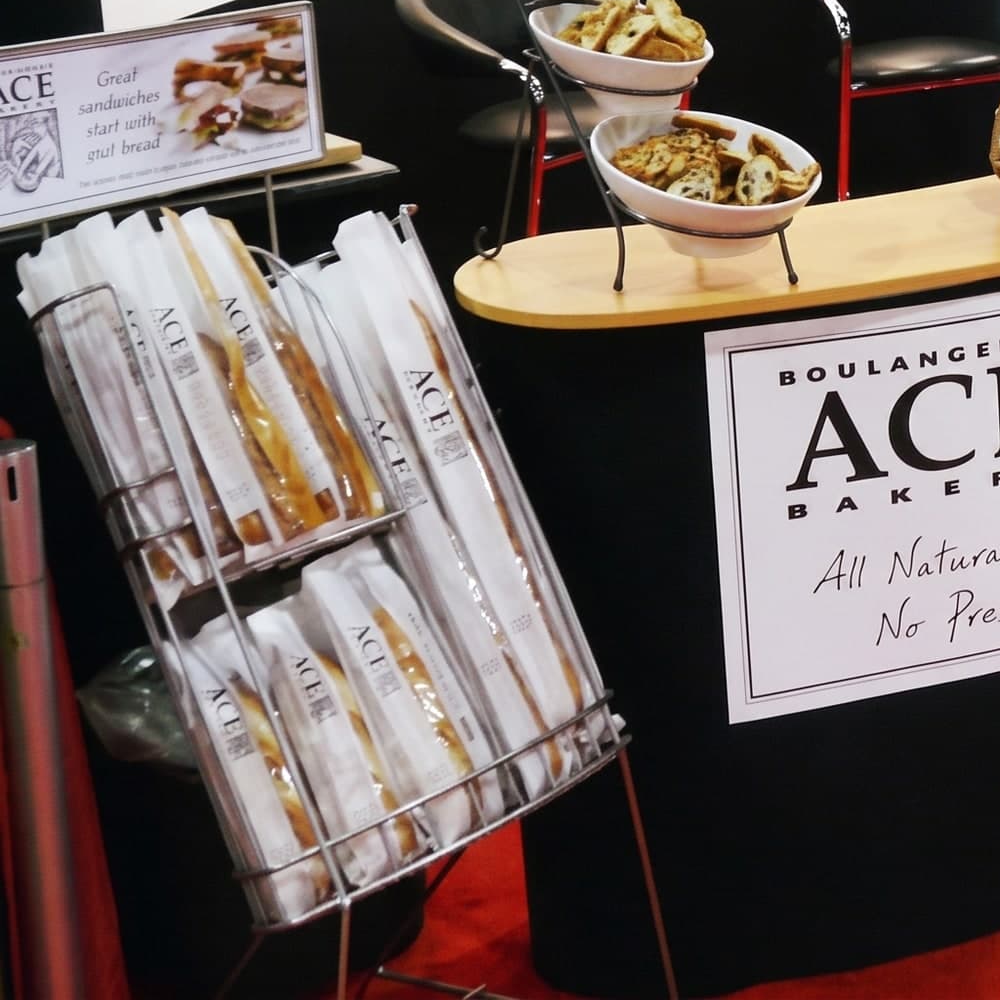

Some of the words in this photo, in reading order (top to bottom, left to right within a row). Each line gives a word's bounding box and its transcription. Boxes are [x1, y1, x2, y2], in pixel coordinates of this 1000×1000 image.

[97, 66, 138, 87] Great
[79, 89, 161, 115] sandwiches
[87, 119, 119, 138] start
[124, 112, 156, 130] with
[121, 137, 160, 155] bread
[152, 308, 188, 353] ACE
[219, 298, 252, 341] ACE
[410, 370, 454, 431] ACE
[813, 549, 867, 594] All
[876, 598, 926, 646] No
[349, 625, 384, 675] ACE
[204, 686, 243, 737] ACE
